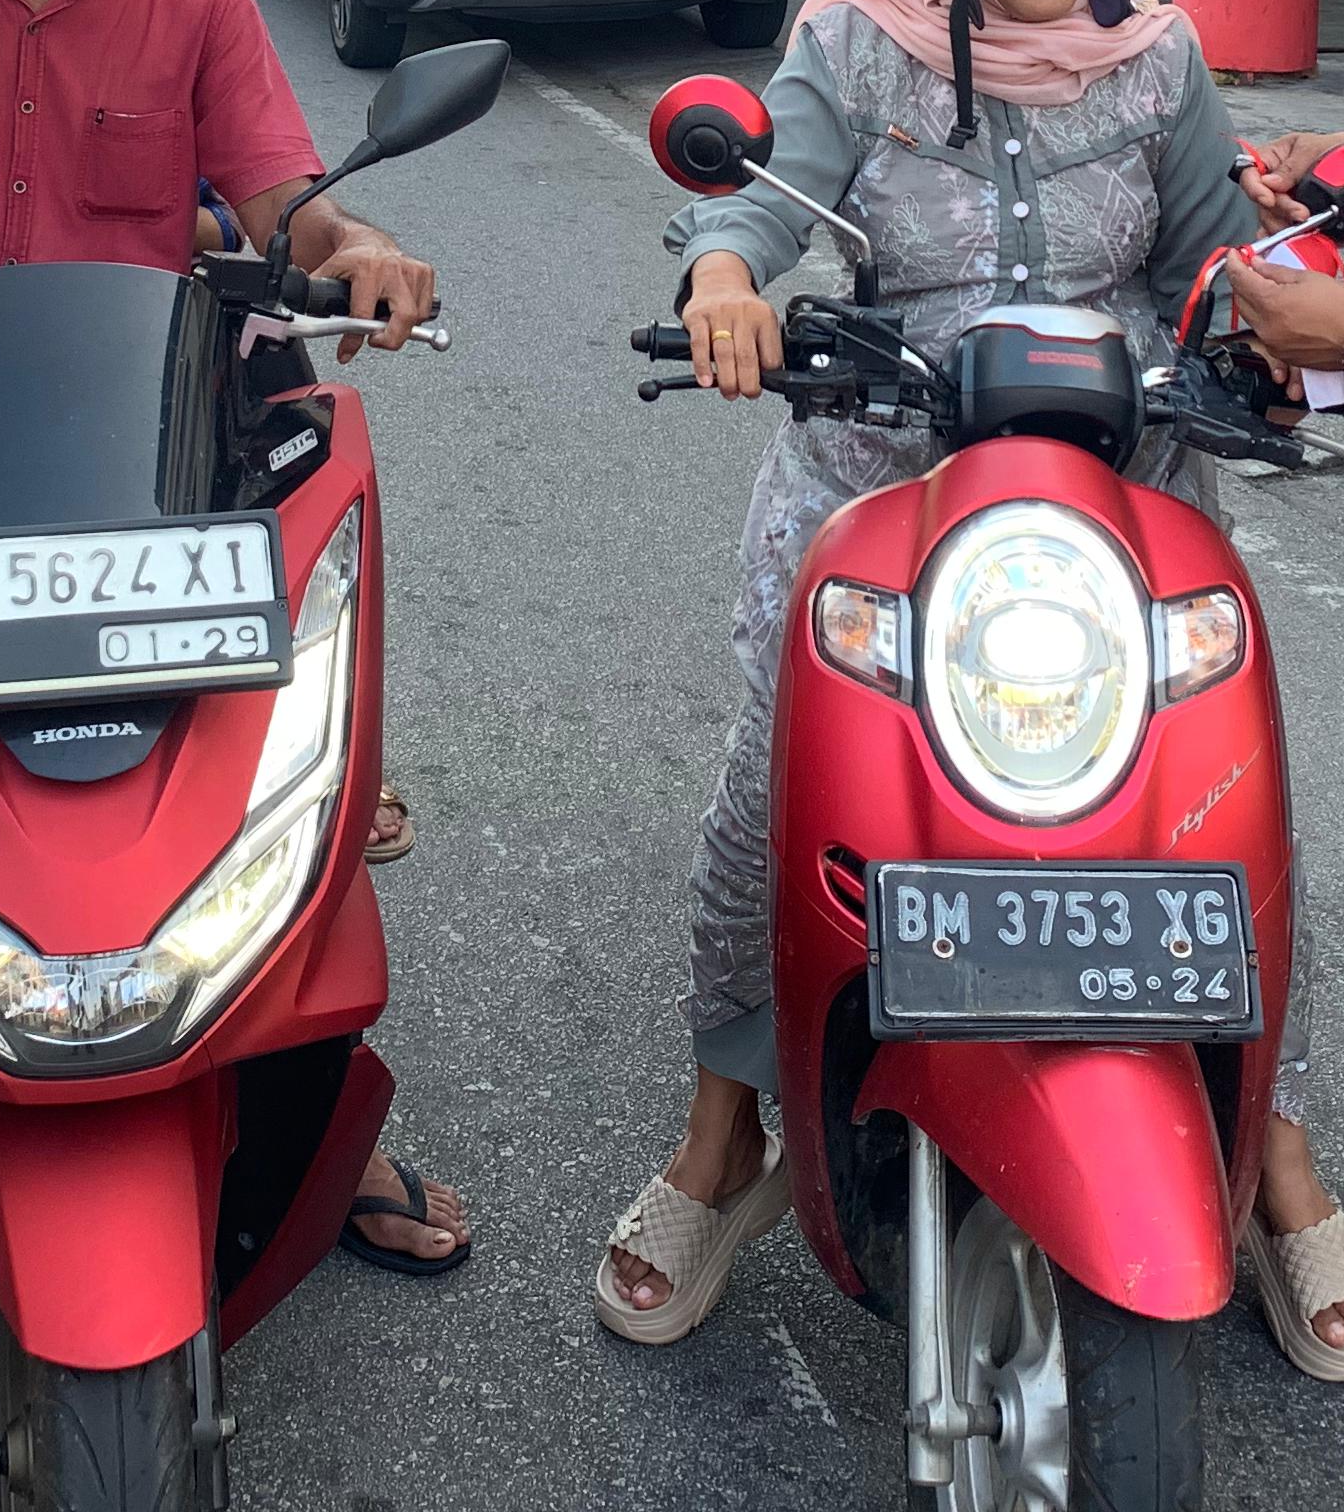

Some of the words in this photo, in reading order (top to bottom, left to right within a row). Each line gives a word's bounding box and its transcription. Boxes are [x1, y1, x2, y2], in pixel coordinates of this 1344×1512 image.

[8, 546, 159, 606] 5624
[181, 538, 248, 598] XI
[32, 721, 143, 746] HONDA
[896, 885, 971, 946] BM
[996, 889, 1132, 948] 3753
[1156, 888, 1231, 948] XG
